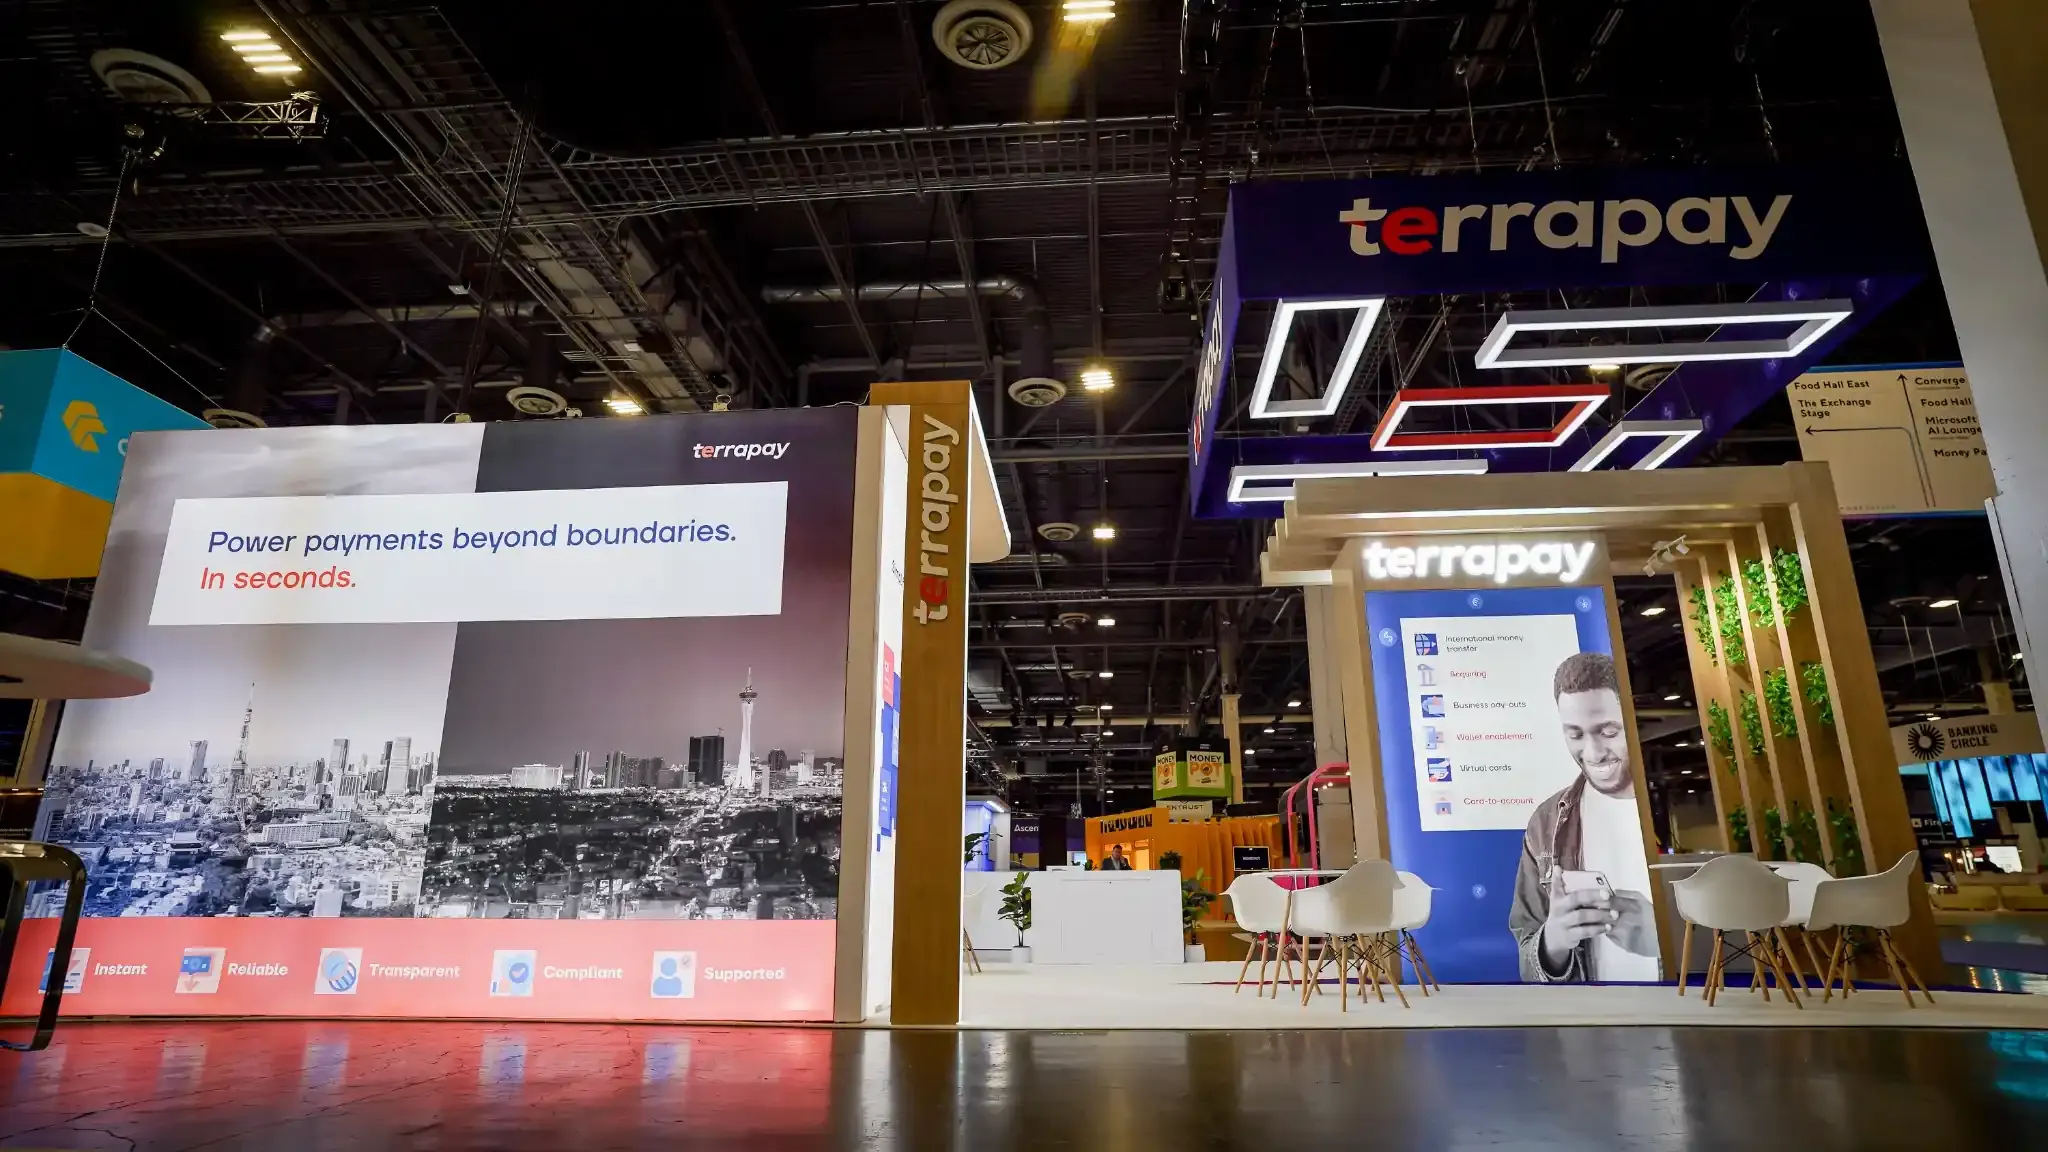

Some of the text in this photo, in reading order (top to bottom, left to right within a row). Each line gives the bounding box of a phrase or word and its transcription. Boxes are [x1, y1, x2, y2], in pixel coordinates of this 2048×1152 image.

[1339, 195, 1793, 264] terrapay
[1794, 380, 1870, 390] Food Hall East
[1915, 377, 1966, 386] Converge
[1798, 399, 1872, 408] The Exchange
[1921, 397, 1972, 407] Food Hall
[1801, 409, 1830, 418] Stage
[1926, 416, 1977, 425] Microsoft
[693, 441, 791, 461] terrapay
[1934, 447, 1970, 458] Money
[912, 413, 960, 626] terrapay
[208, 518, 738, 557] Power payments beyond boundaries.
[1363, 540, 1596, 584] terrapay
[200, 565, 358, 590] In seconds.
[1445, 635, 1524, 643] International money
[1453, 701, 1488, 709] Business
[1457, 733, 1482, 741] Wallet
[1948, 724, 1998, 738] BANKING
[1951, 736, 1990, 749] CIRCLE
[1157, 755, 1175, 765] MONEY
[1189, 754, 1221, 763] MONEY
[1189, 762, 1222, 776] POT
[94, 962, 148, 976] Instant
[227, 962, 289, 977] Reliable
[369, 963, 461, 979] Transparent
[543, 964, 624, 981] Compliant
[703, 966, 786, 982] Supported
